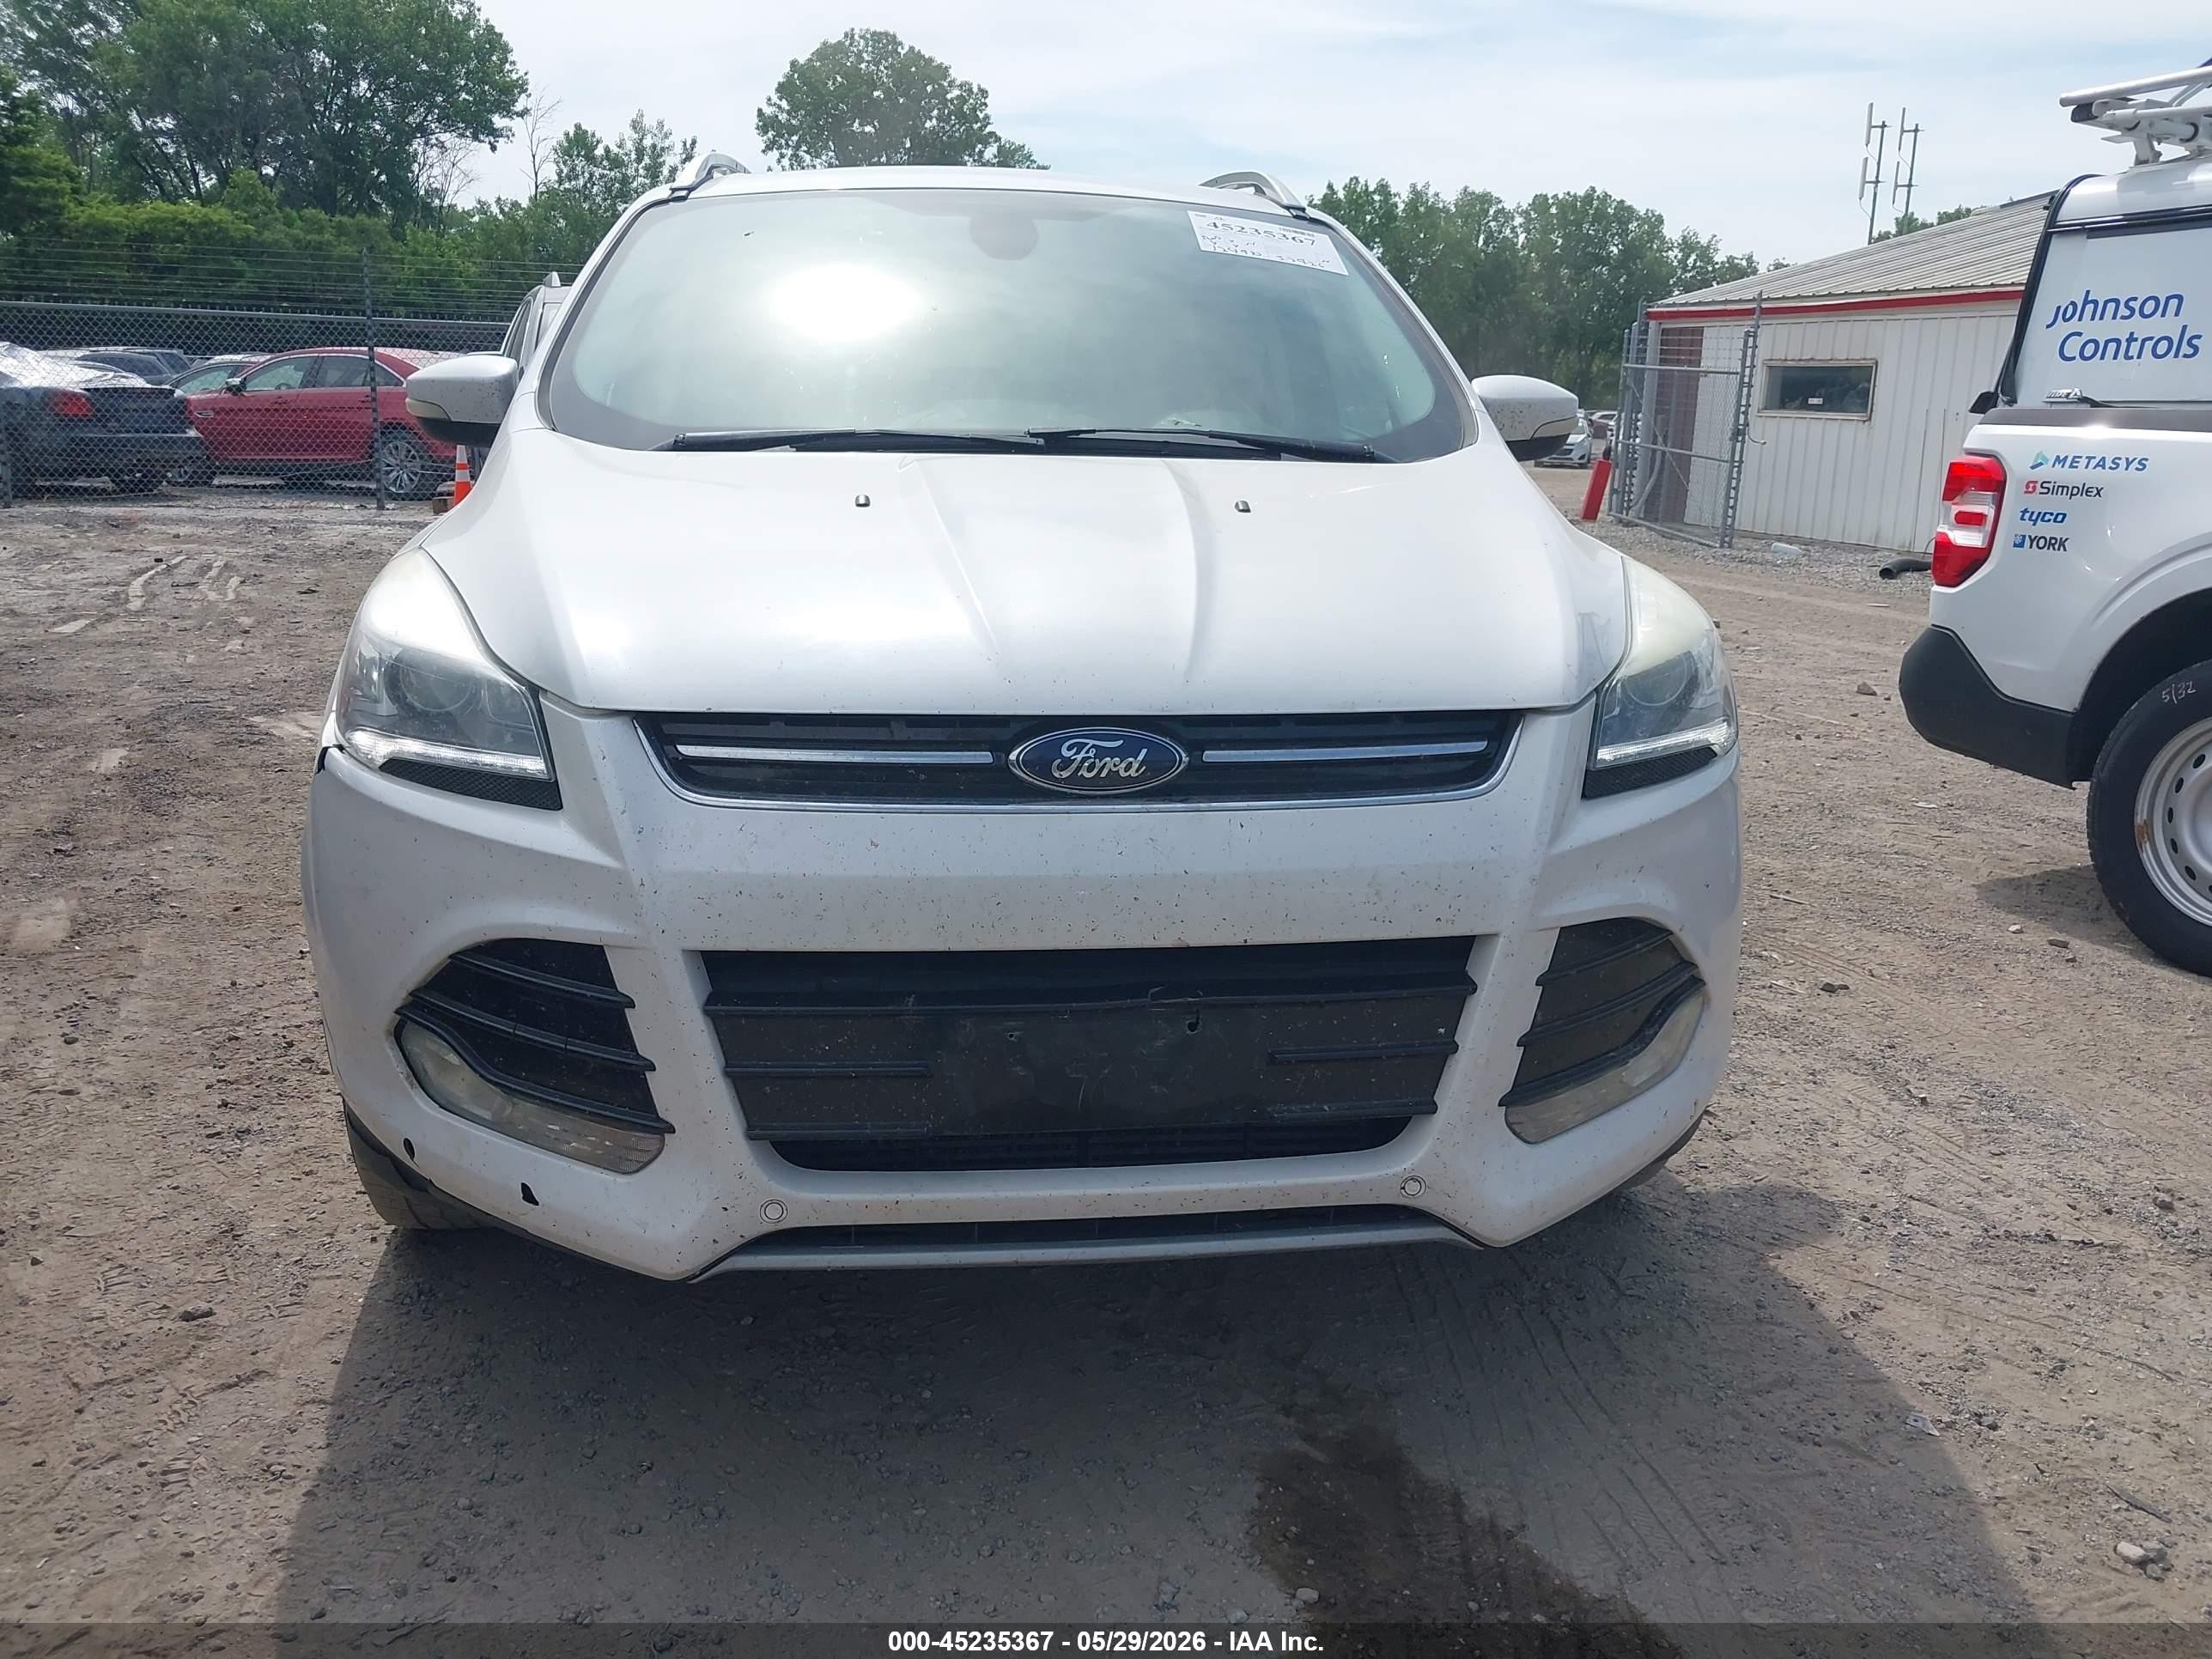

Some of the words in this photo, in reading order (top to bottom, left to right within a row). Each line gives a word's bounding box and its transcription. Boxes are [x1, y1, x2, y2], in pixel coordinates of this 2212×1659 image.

[1206, 221, 1316, 246] 45235367
[2045, 289, 2185, 329] Johnson
[2058, 325, 2203, 362] Controls
[2051, 455, 2148, 471] METASYS
[2039, 481, 2104, 500] Simplex
[2020, 507, 2067, 526] tyco
[2027, 535, 2069, 551] YORK
[1051, 738, 1147, 779] Ford
